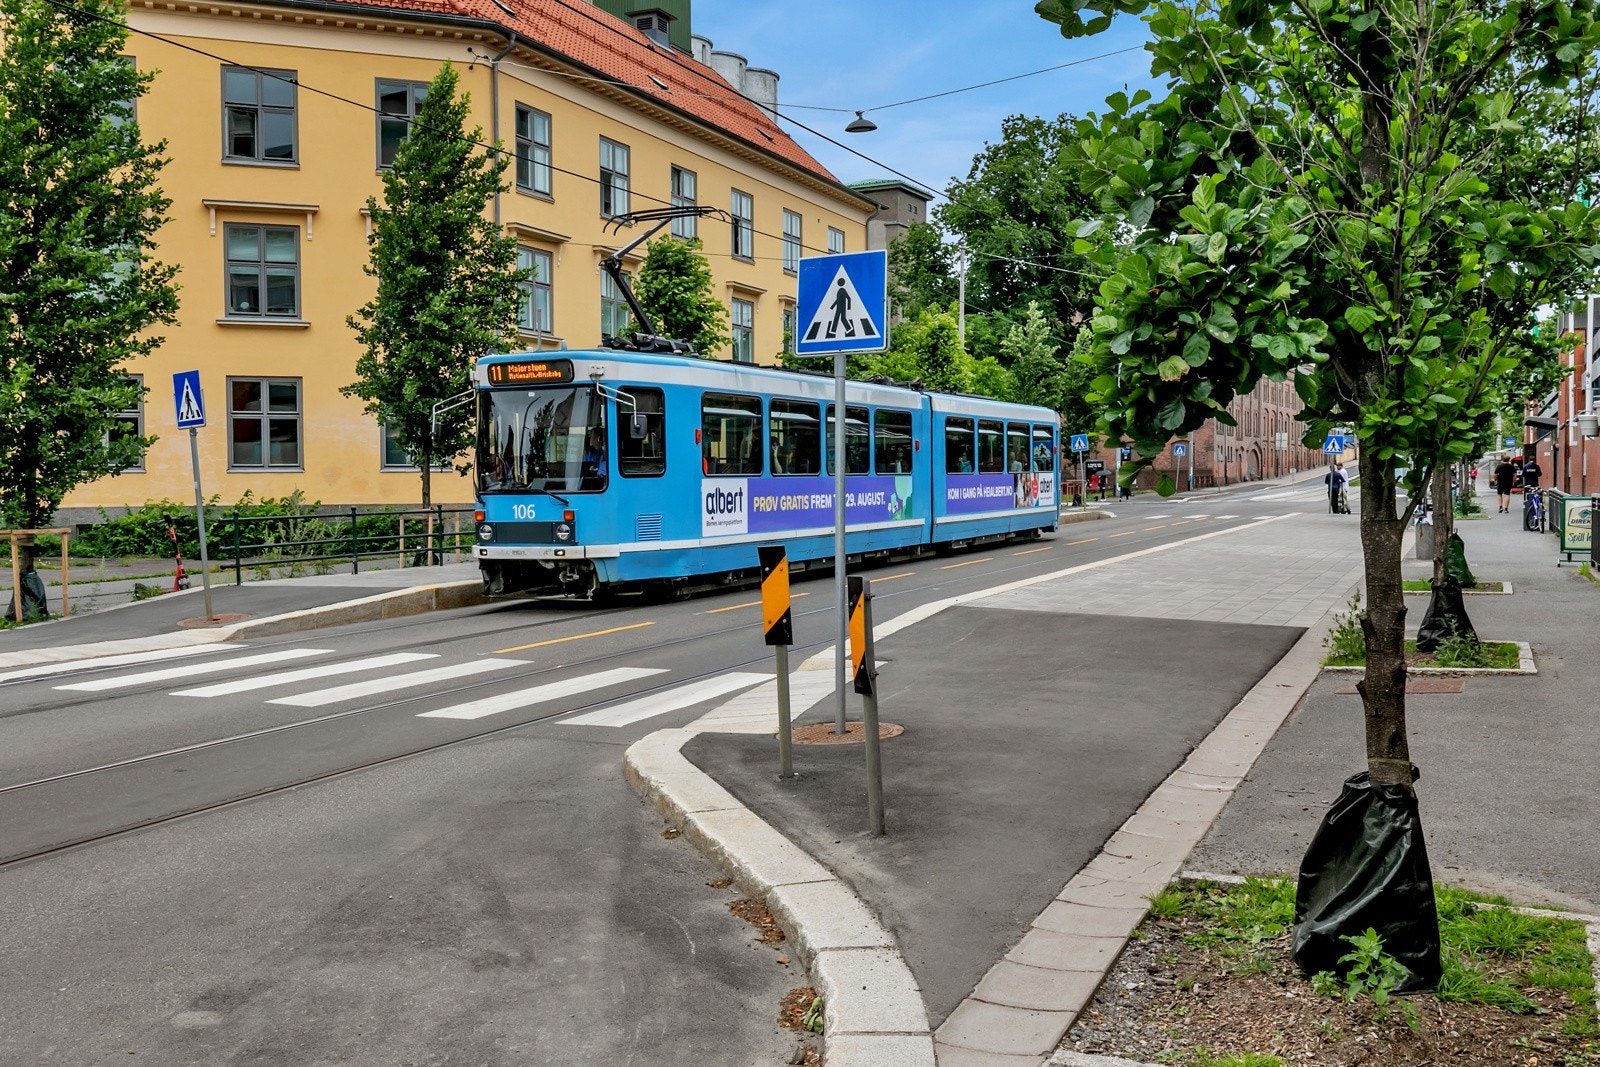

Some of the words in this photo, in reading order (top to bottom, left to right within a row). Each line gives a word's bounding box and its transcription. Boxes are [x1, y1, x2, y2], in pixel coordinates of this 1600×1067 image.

[491, 365, 502, 381] 11
[705, 486, 743, 514] albert
[947, 488, 959, 500] KOM
[963, 486, 976, 499] GANG
[977, 484, 983, 497] PÅ
[753, 495, 779, 512] PRØV
[780, 495, 809, 511] GRATIS
[811, 493, 832, 509] FREM
[845, 493, 857, 507] 29.
[857, 491, 886, 506] AUGUST.
[512, 504, 536, 519] 106
